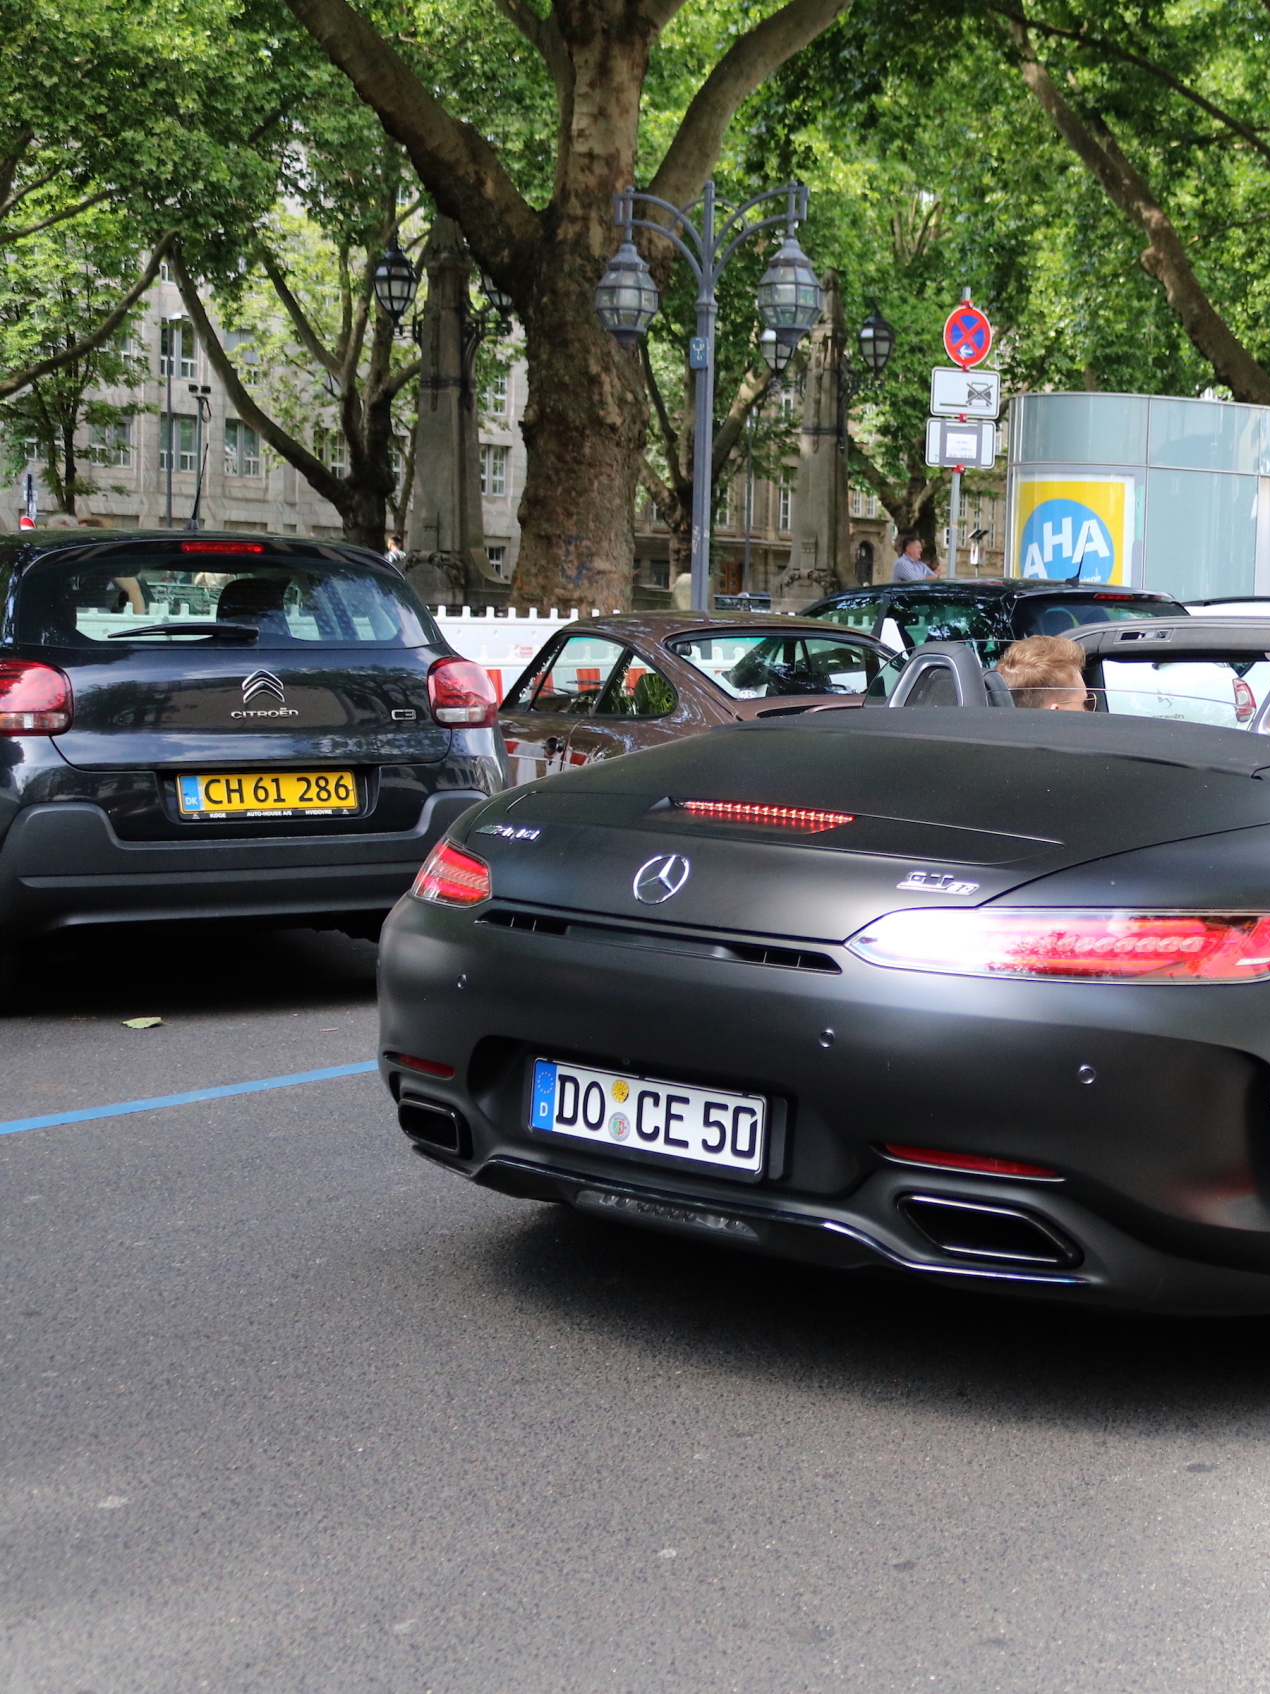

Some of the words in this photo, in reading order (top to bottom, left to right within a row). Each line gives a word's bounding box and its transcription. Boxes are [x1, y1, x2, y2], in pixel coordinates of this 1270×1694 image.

[1023, 516, 1110, 579] AHA
[391, 709, 417, 721] C3
[204, 778, 245, 805] CH
[253, 776, 286, 803] 61
[296, 774, 350, 802] 286
[185, 797, 199, 806] DK
[539, 1102, 548, 1117] D
[556, 1074, 606, 1131] DO
[636, 1090, 690, 1149] CE
[701, 1100, 758, 1159] 50
